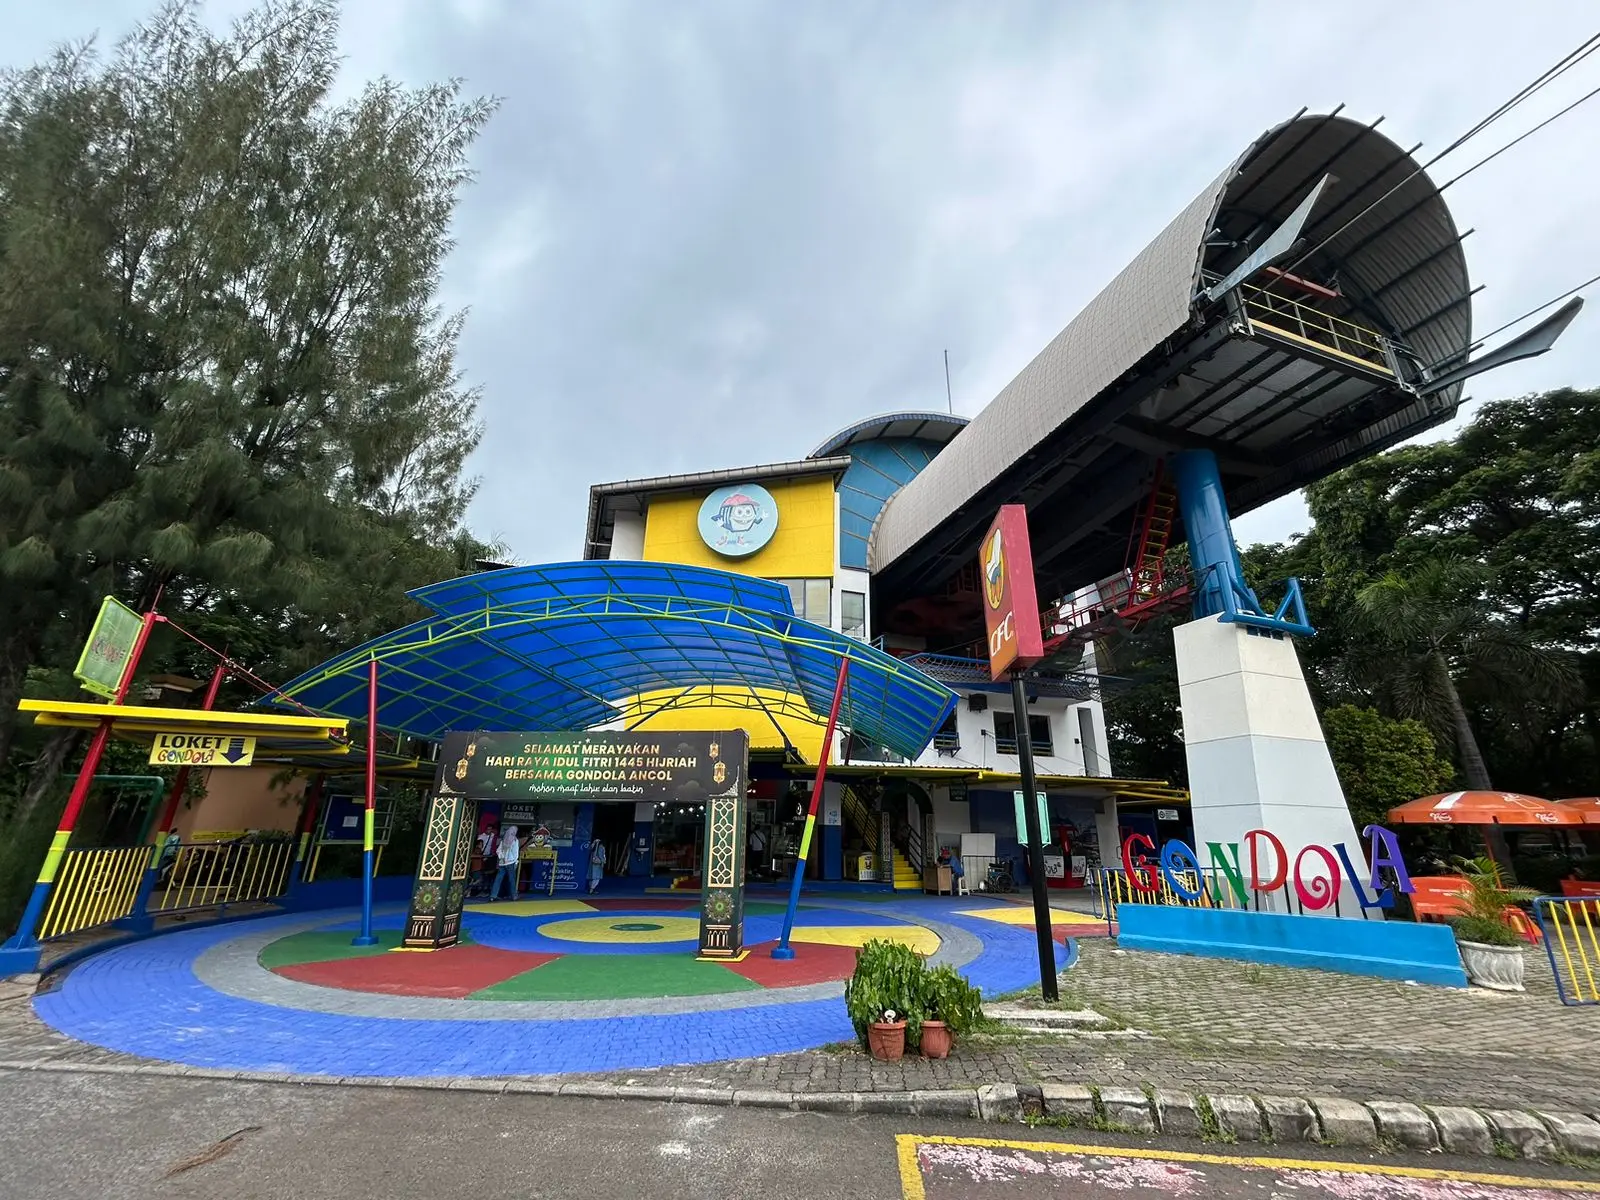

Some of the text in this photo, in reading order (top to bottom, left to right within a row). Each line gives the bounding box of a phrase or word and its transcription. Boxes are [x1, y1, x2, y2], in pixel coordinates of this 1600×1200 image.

[990, 611, 1013, 657] CFC
[160, 735, 225, 749] LOKET
[157, 748, 215, 763] GONDOLA
[524, 744, 660, 755] SELAMAT MERAYAKAN
[485, 756, 697, 768] HARI RAYA IDUL FITRI 1445 HIJRIAH
[504, 769, 673, 781] BERSAMA GONDOLA ANCOL
[556, 783, 579, 795] maaf
[1122, 824, 1417, 911] GONDOLA
